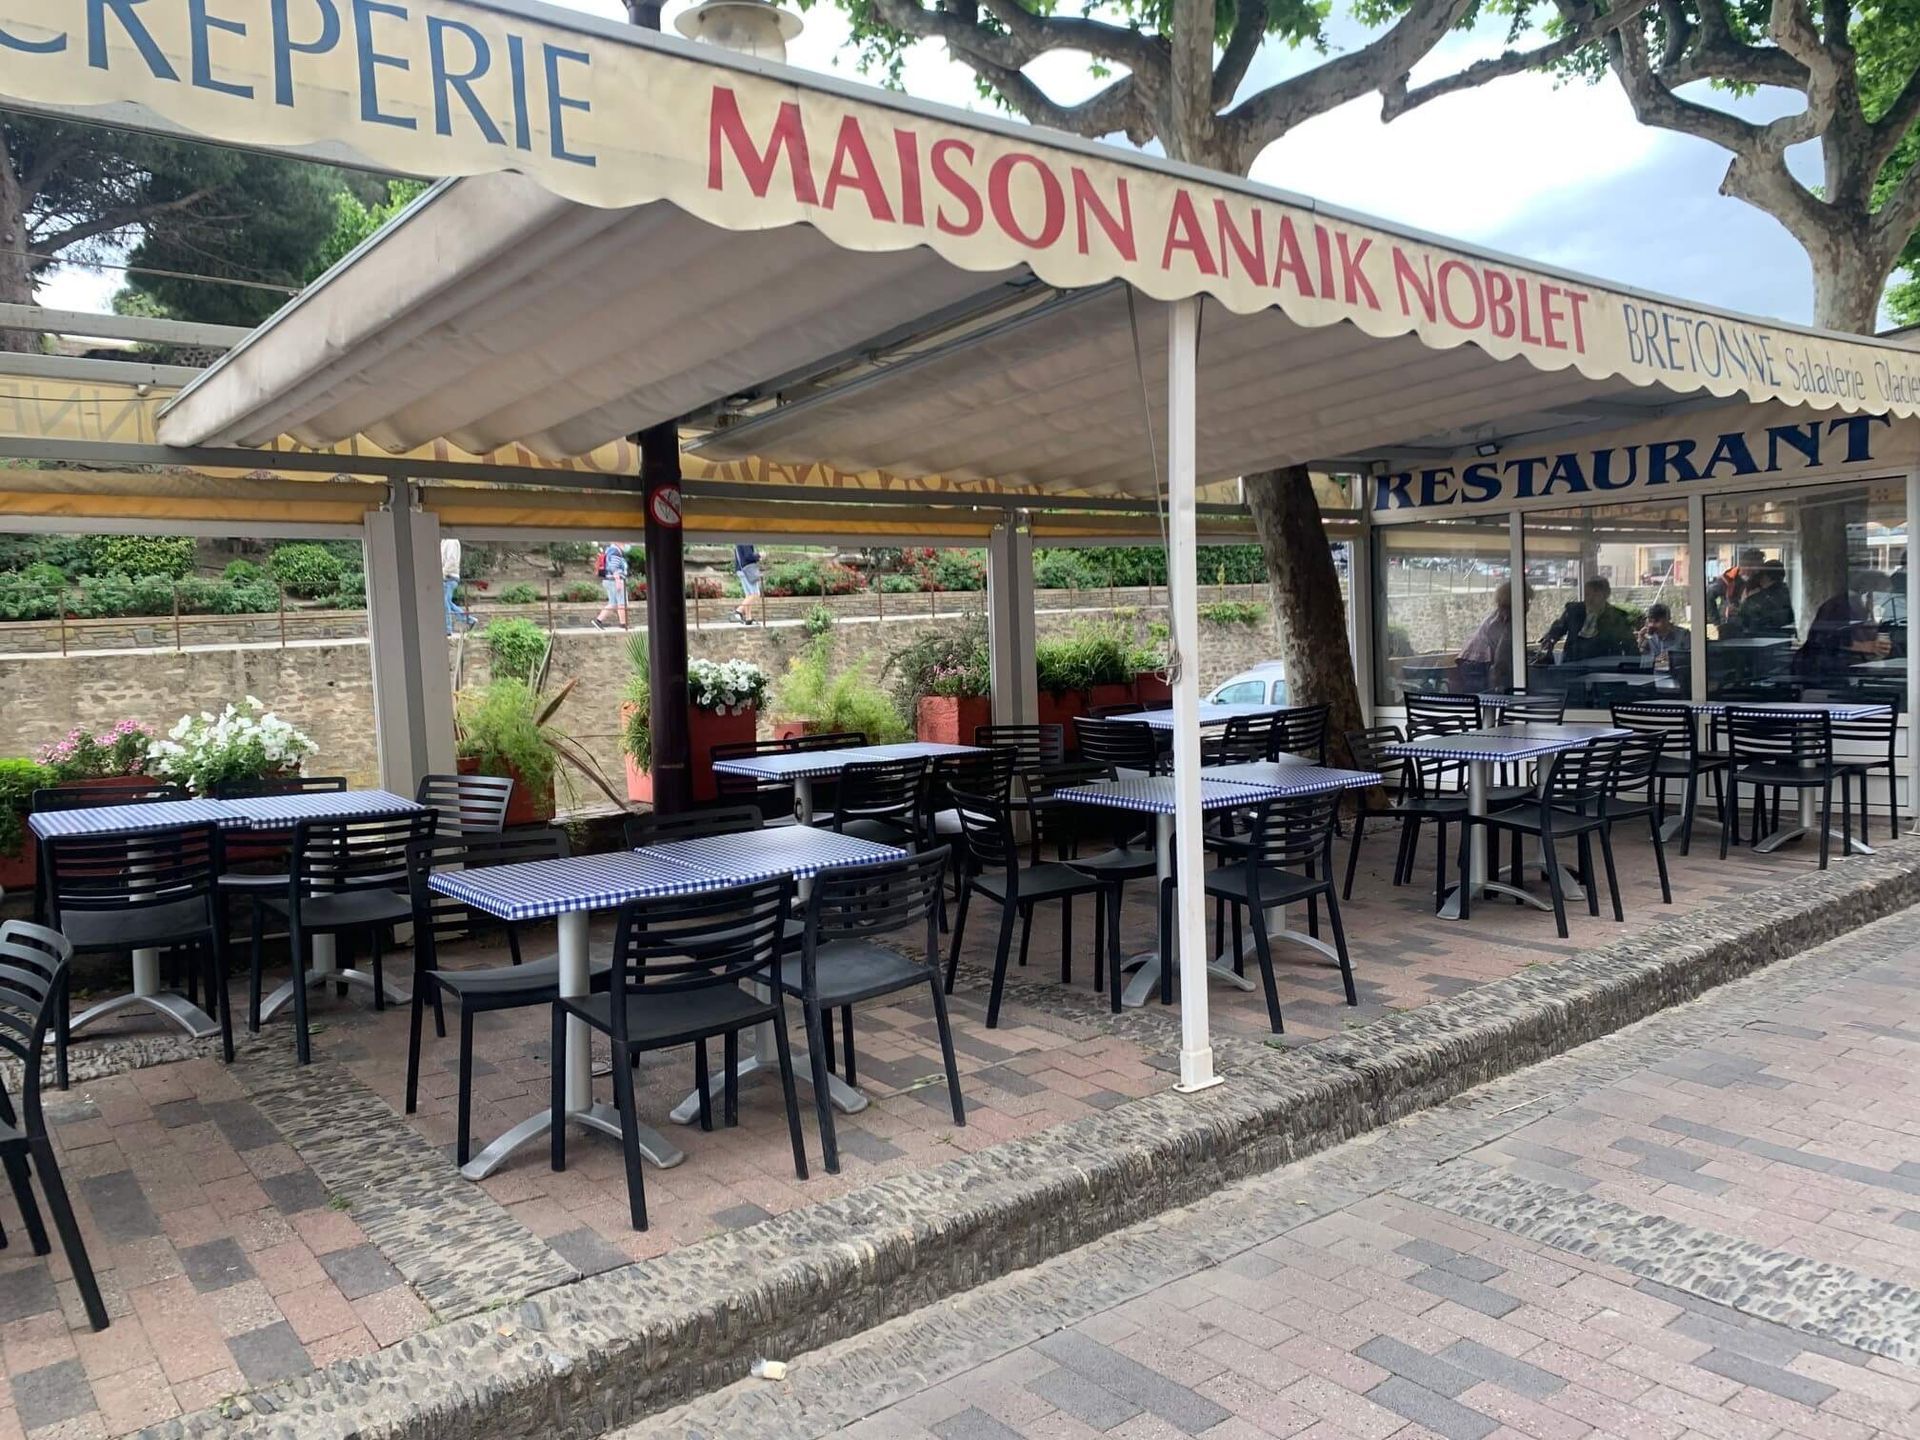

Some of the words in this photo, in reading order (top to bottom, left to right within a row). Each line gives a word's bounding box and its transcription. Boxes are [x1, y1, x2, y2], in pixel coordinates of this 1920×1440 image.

[0, 0, 597, 167] REPERIE
[707, 85, 1137, 262] MAISON
[1161, 189, 1381, 310] ANAIK
[1392, 246, 1588, 354] NOBLET
[1622, 303, 1782, 387] BRETONNE
[1785, 346, 1867, 401] Saladerie
[1373, 413, 1892, 511] RESTAURANT
